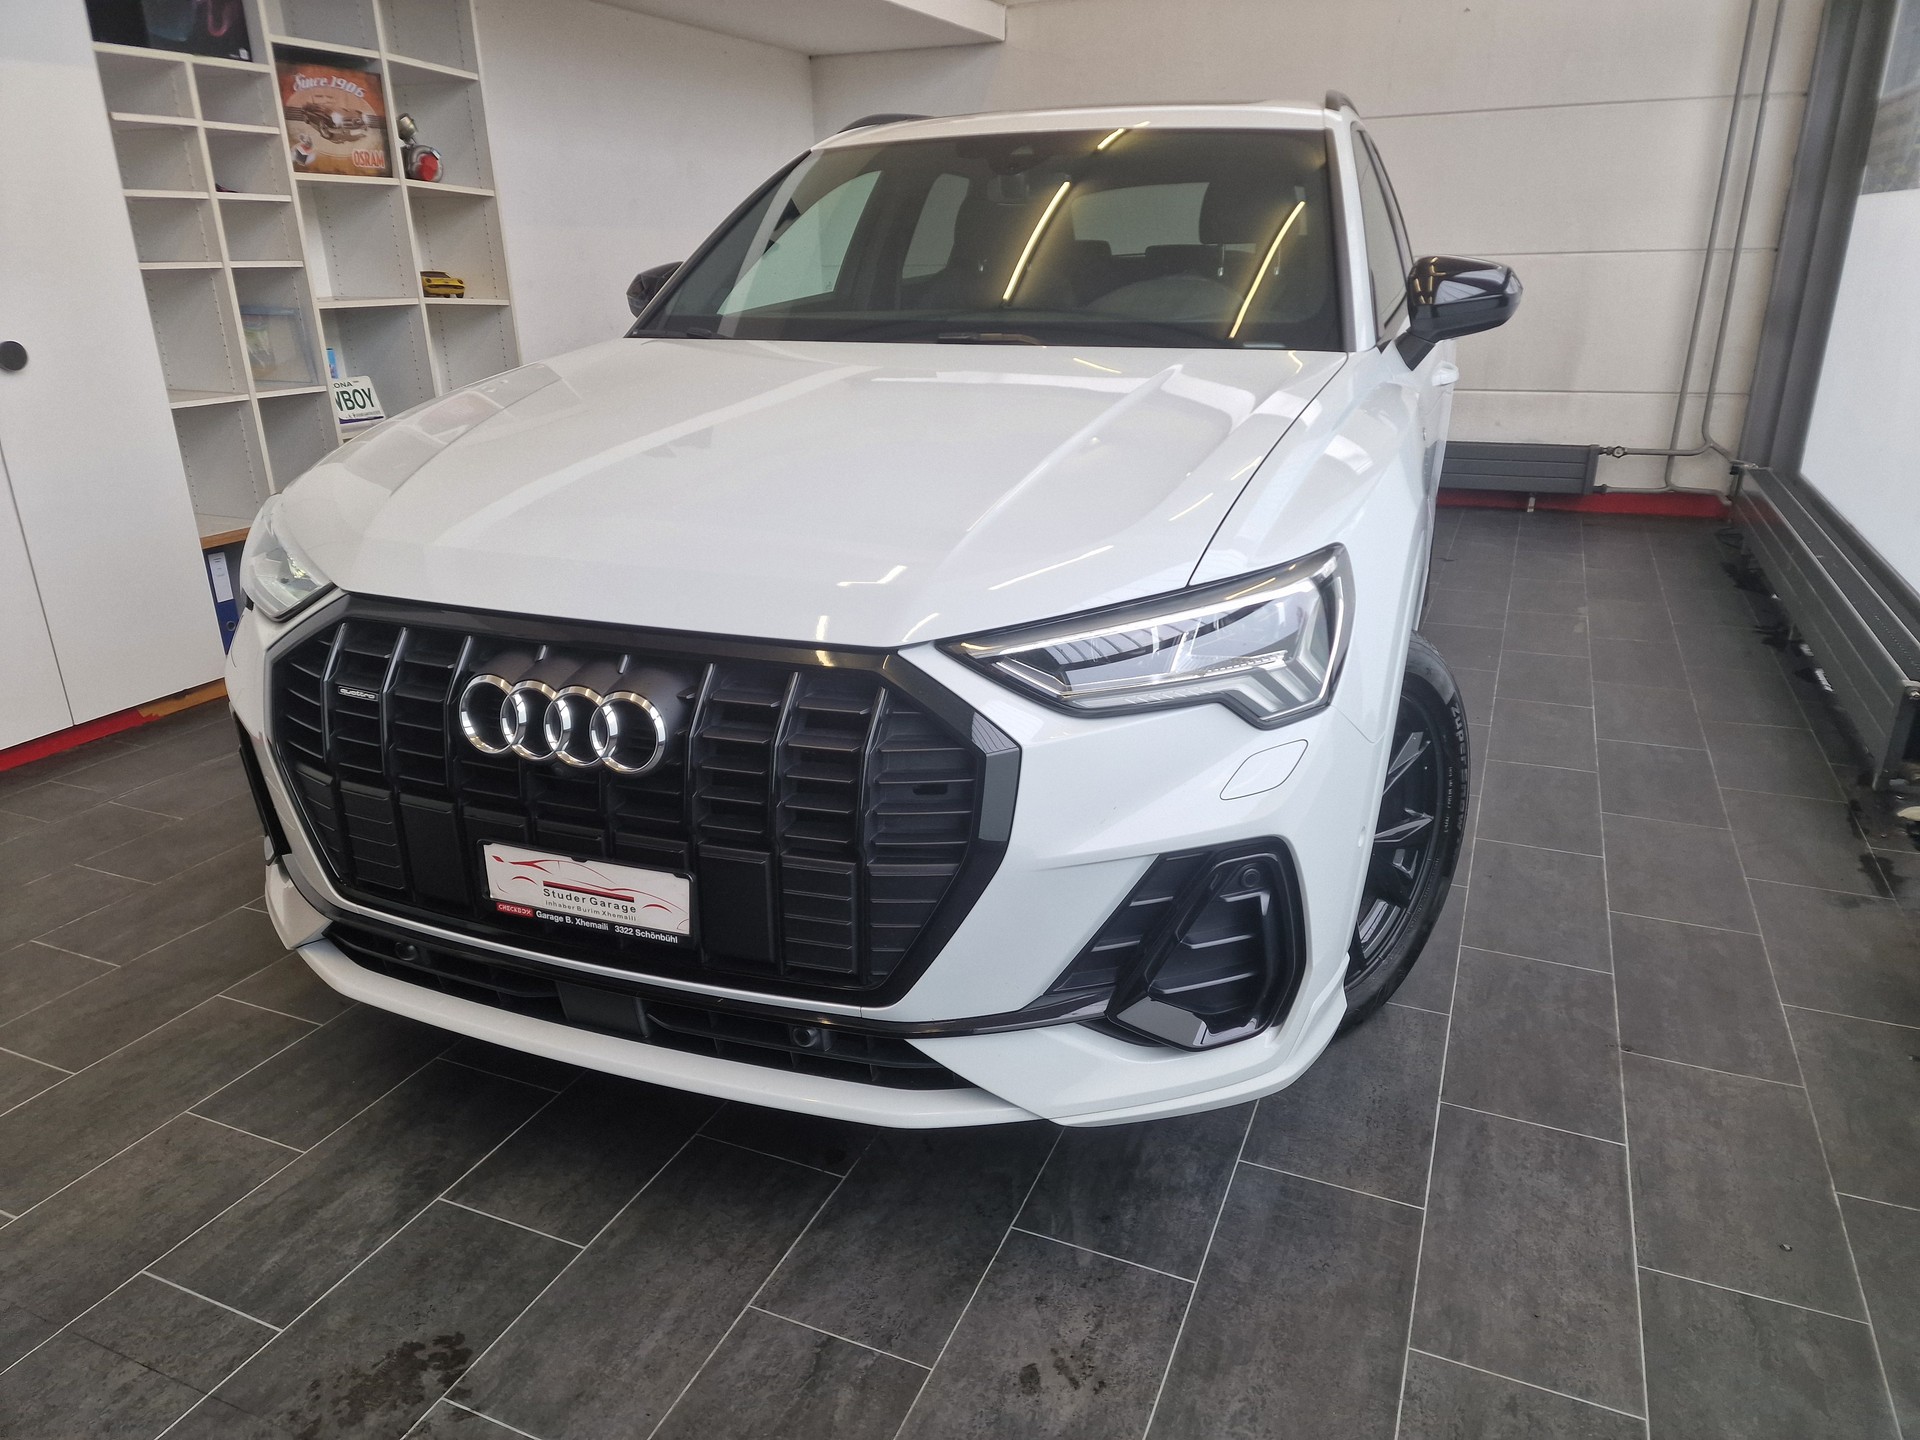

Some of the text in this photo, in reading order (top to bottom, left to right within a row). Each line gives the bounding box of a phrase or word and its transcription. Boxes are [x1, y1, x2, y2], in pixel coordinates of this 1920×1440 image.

[293, 72, 365, 98] Since 1906
[353, 150, 385, 168] OSRAM
[543, 888, 637, 914] Studer Garage
[576, 905, 600, 915] Burim
[601, 910, 637, 922] Xhemaili
[536, 911, 678, 944] Garage B. Xhemaili 3322 Schönbühl
